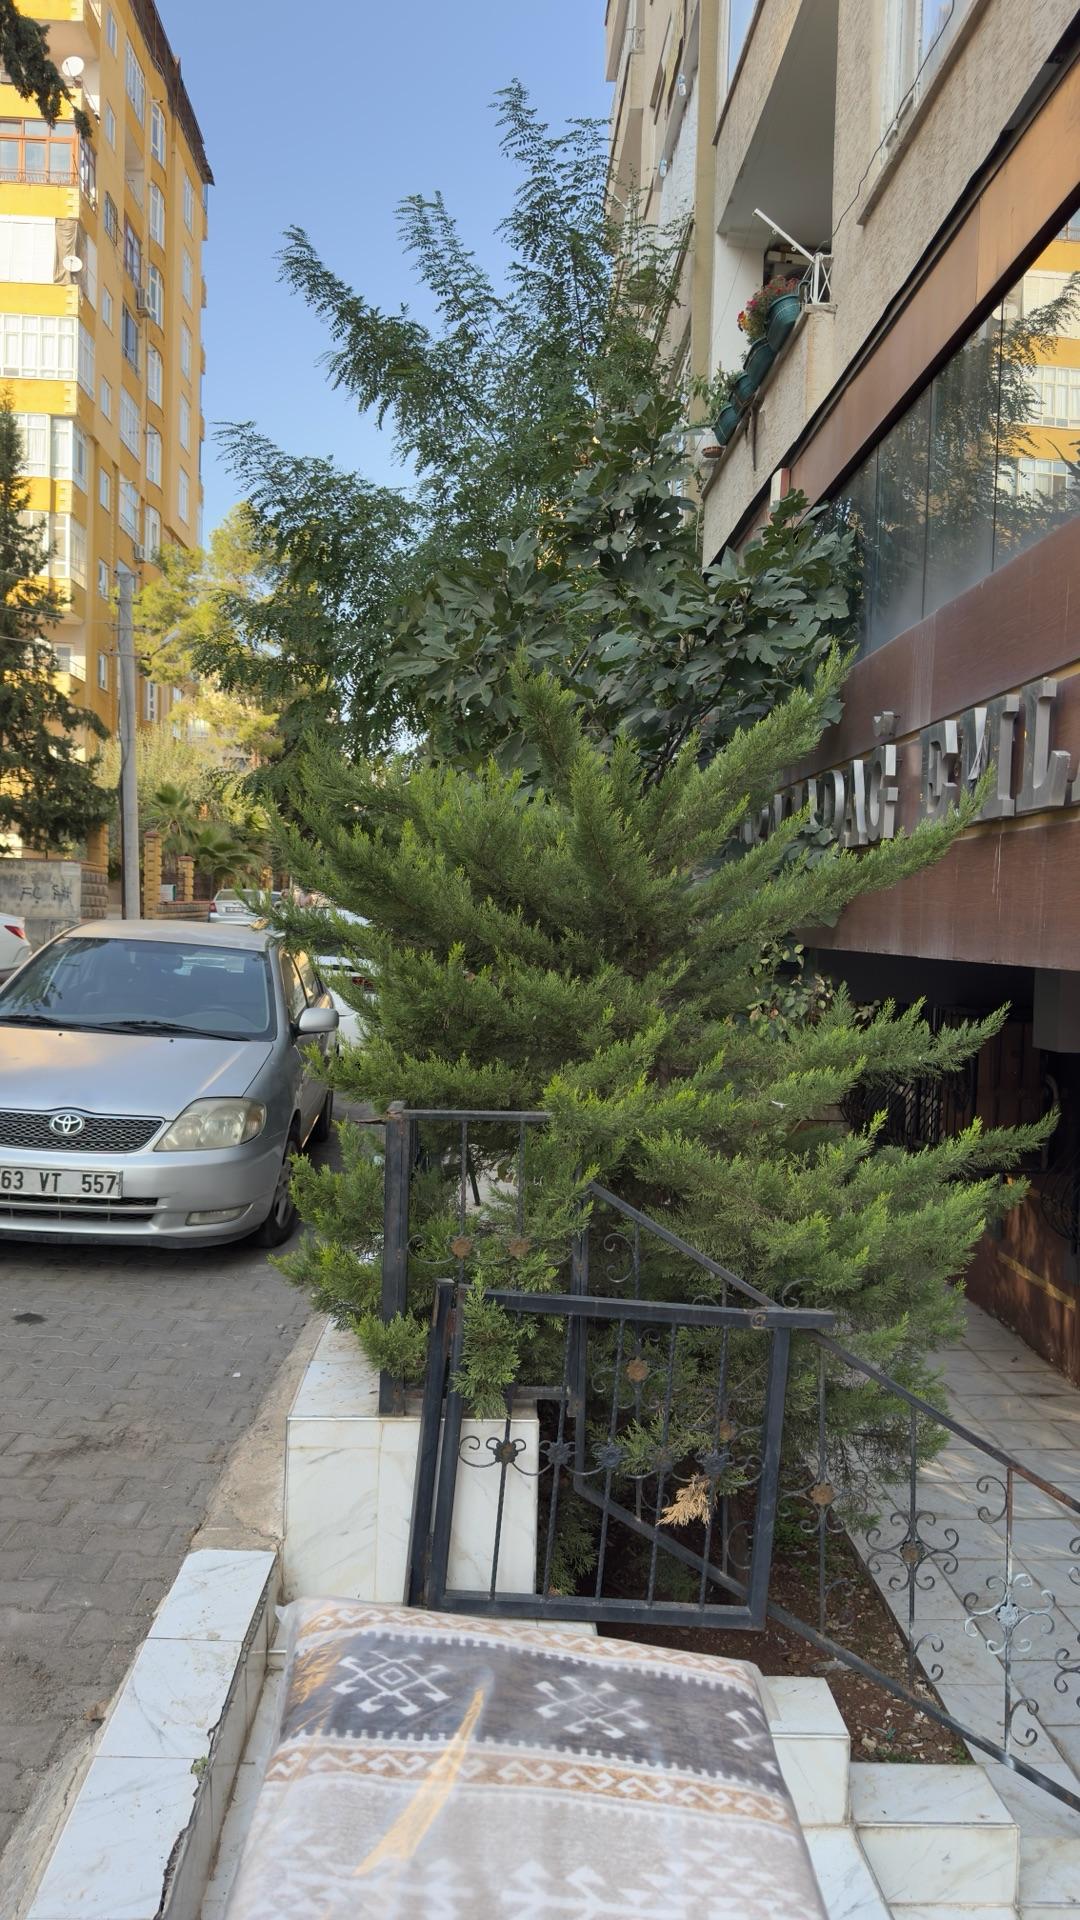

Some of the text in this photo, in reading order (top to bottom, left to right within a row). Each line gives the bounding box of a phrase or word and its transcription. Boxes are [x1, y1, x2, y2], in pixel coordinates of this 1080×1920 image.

[919, 677, 1080, 828] EML
[1, 1170, 117, 1194] 63 VT 557
